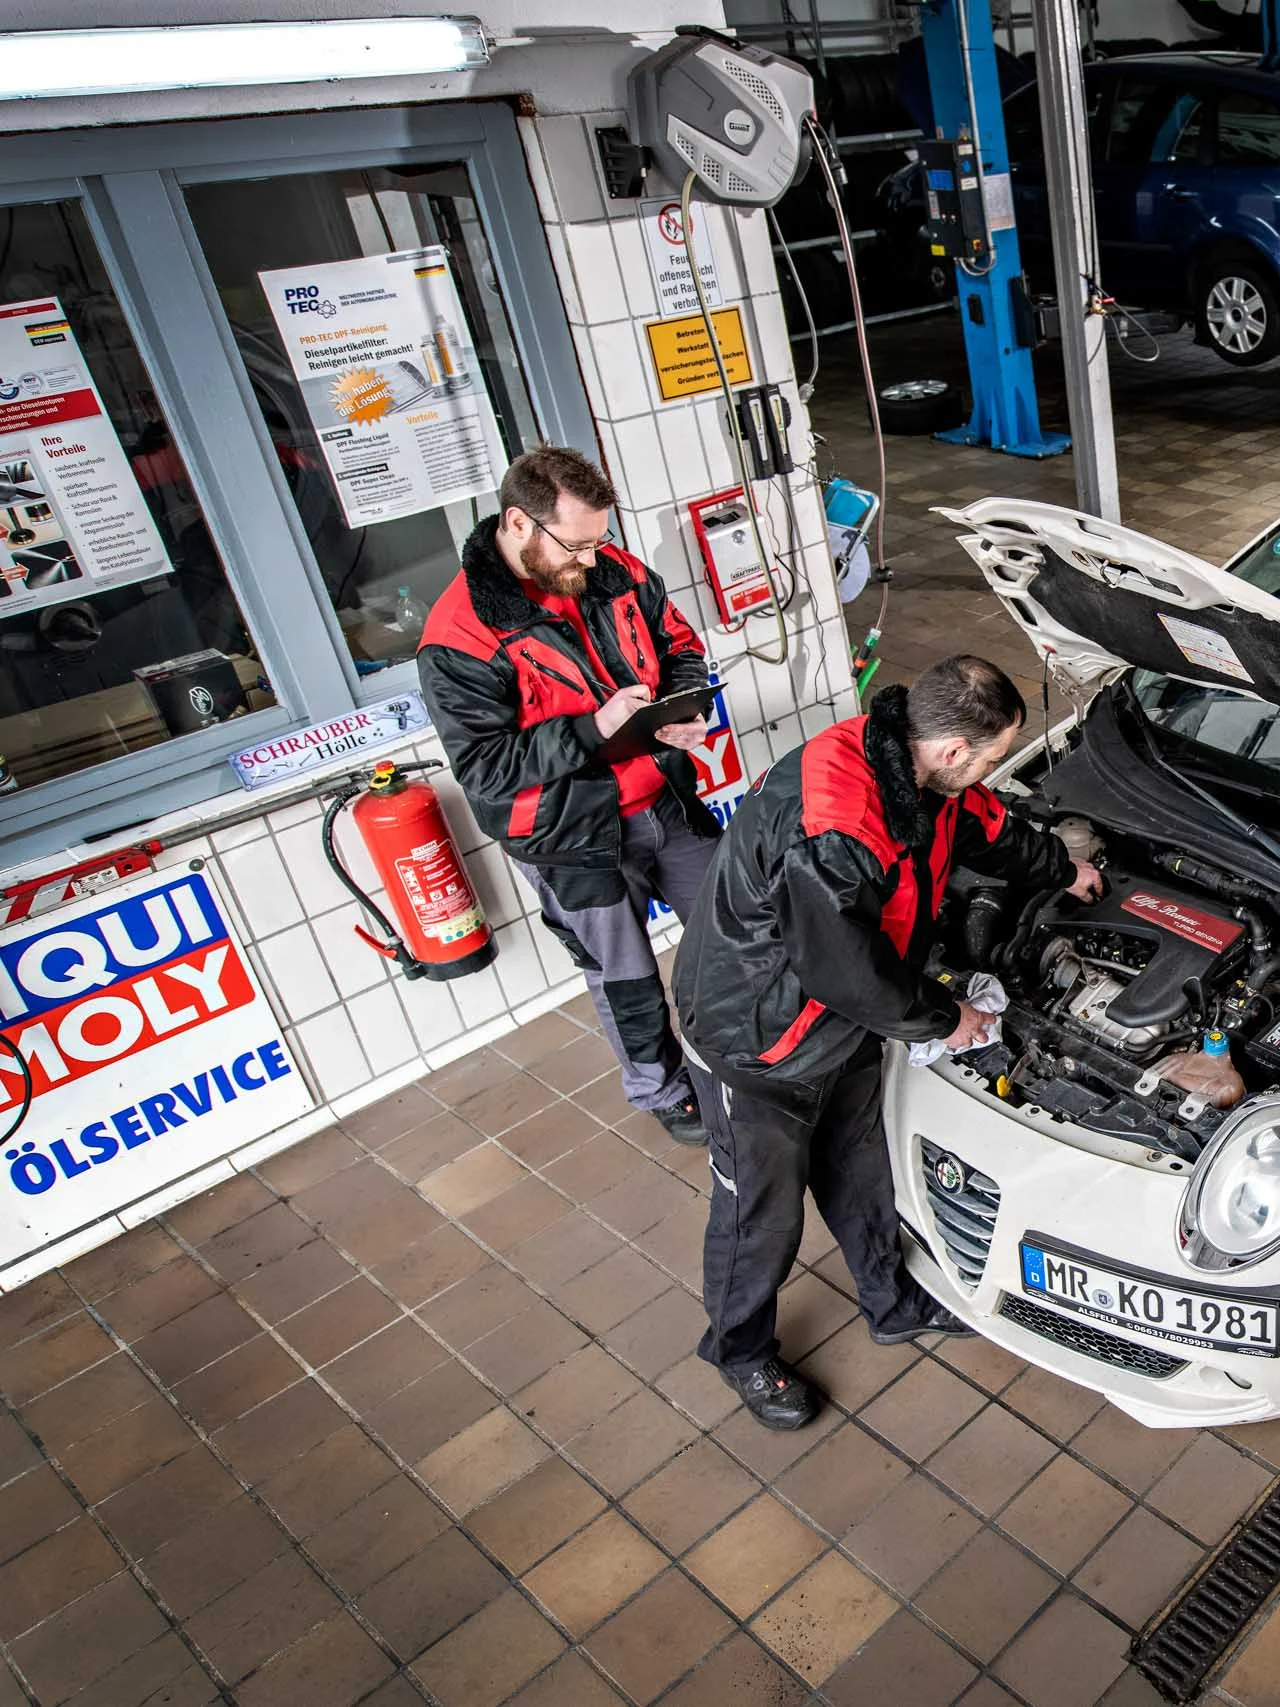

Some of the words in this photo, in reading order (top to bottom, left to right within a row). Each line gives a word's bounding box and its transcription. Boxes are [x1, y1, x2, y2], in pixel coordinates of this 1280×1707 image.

[660, 270, 690, 282] offenes
[285, 286, 319, 301] PRO
[662, 285, 678, 297] und
[287, 300, 319, 315] TEC
[676, 328, 705, 339] Betreten
[304, 338, 389, 359] Dieselpartikelfilter:
[308, 355, 348, 371] Reinigen
[349, 351, 374, 364] leicht
[375, 344, 414, 361] gemacht!
[352, 377, 384, 397] haben
[339, 404, 356, 417] die
[405, 411, 439, 425] Vorteile
[41, 434, 63, 447] Ihre
[46, 443, 87, 459] Vorteile
[240, 713, 373, 769] SCHRAUBER
[316, 734, 367, 759] Hölle
[1130, 895, 1160, 910] Alfa
[1159, 904, 1201, 926] Romeo
[1174, 921, 1196, 934] TURBO
[1194, 930, 1223, 946] BENZINA
[0, 884, 213, 1023] IQUI
[5, 1040, 291, 1196] ÖLSERVICE
[1046, 1258, 1089, 1303] MR
[1118, 1281, 1164, 1323] KO
[1175, 1297, 1272, 1344] 1981
[1078, 1306, 1118, 1325] ALSFELD
[1133, 1323, 1214, 1349] 06631/8029953
